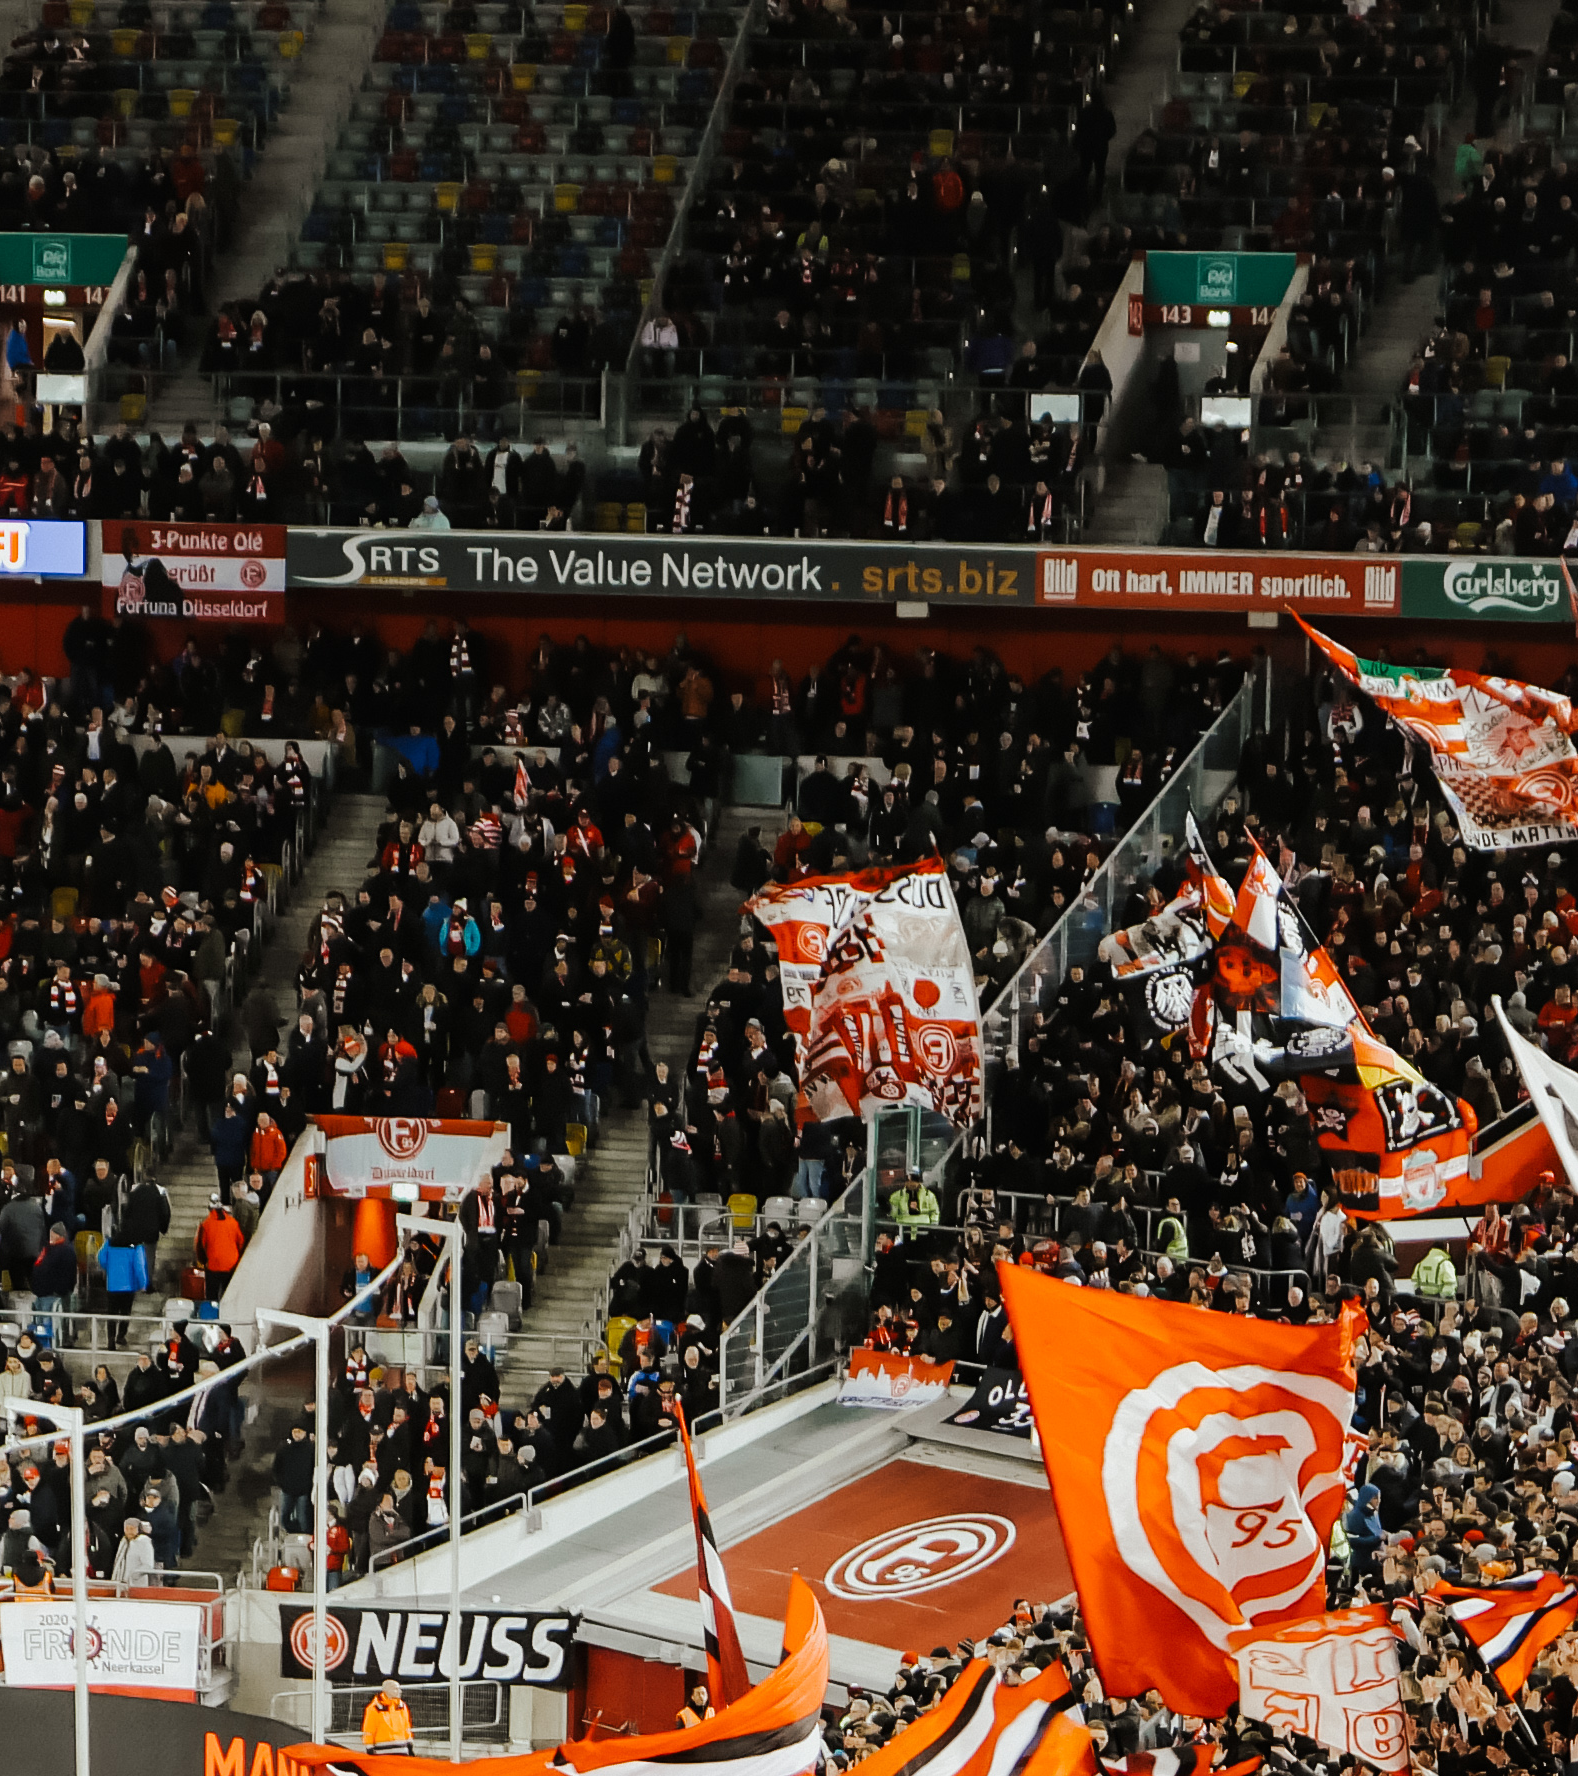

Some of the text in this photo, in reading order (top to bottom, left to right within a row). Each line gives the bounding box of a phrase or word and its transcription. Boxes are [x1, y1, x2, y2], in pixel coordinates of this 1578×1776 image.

[1160, 305, 1192, 324] 143
[152, 530, 263, 552] 3-Punkte Olé
[467, 548, 538, 584] The
[550, 549, 653, 587] Value
[662, 552, 822, 592] Network
[862, 560, 1019, 597] srts.biz
[1091, 568, 1121, 594] Oft
[1125, 568, 1173, 597] hart,
[1179, 569, 1253, 597] IMMER
[1443, 562, 1560, 604] Carlsberg
[182, 599, 267, 619] Düsseldorf
[1231, 1513, 1304, 1549] 95
[879, 1561, 922, 1578] 95
[38, 1613, 68, 1627] 2020
[353, 1610, 571, 1684] NEUSS
[101, 1659, 165, 1676] Neerkassel
